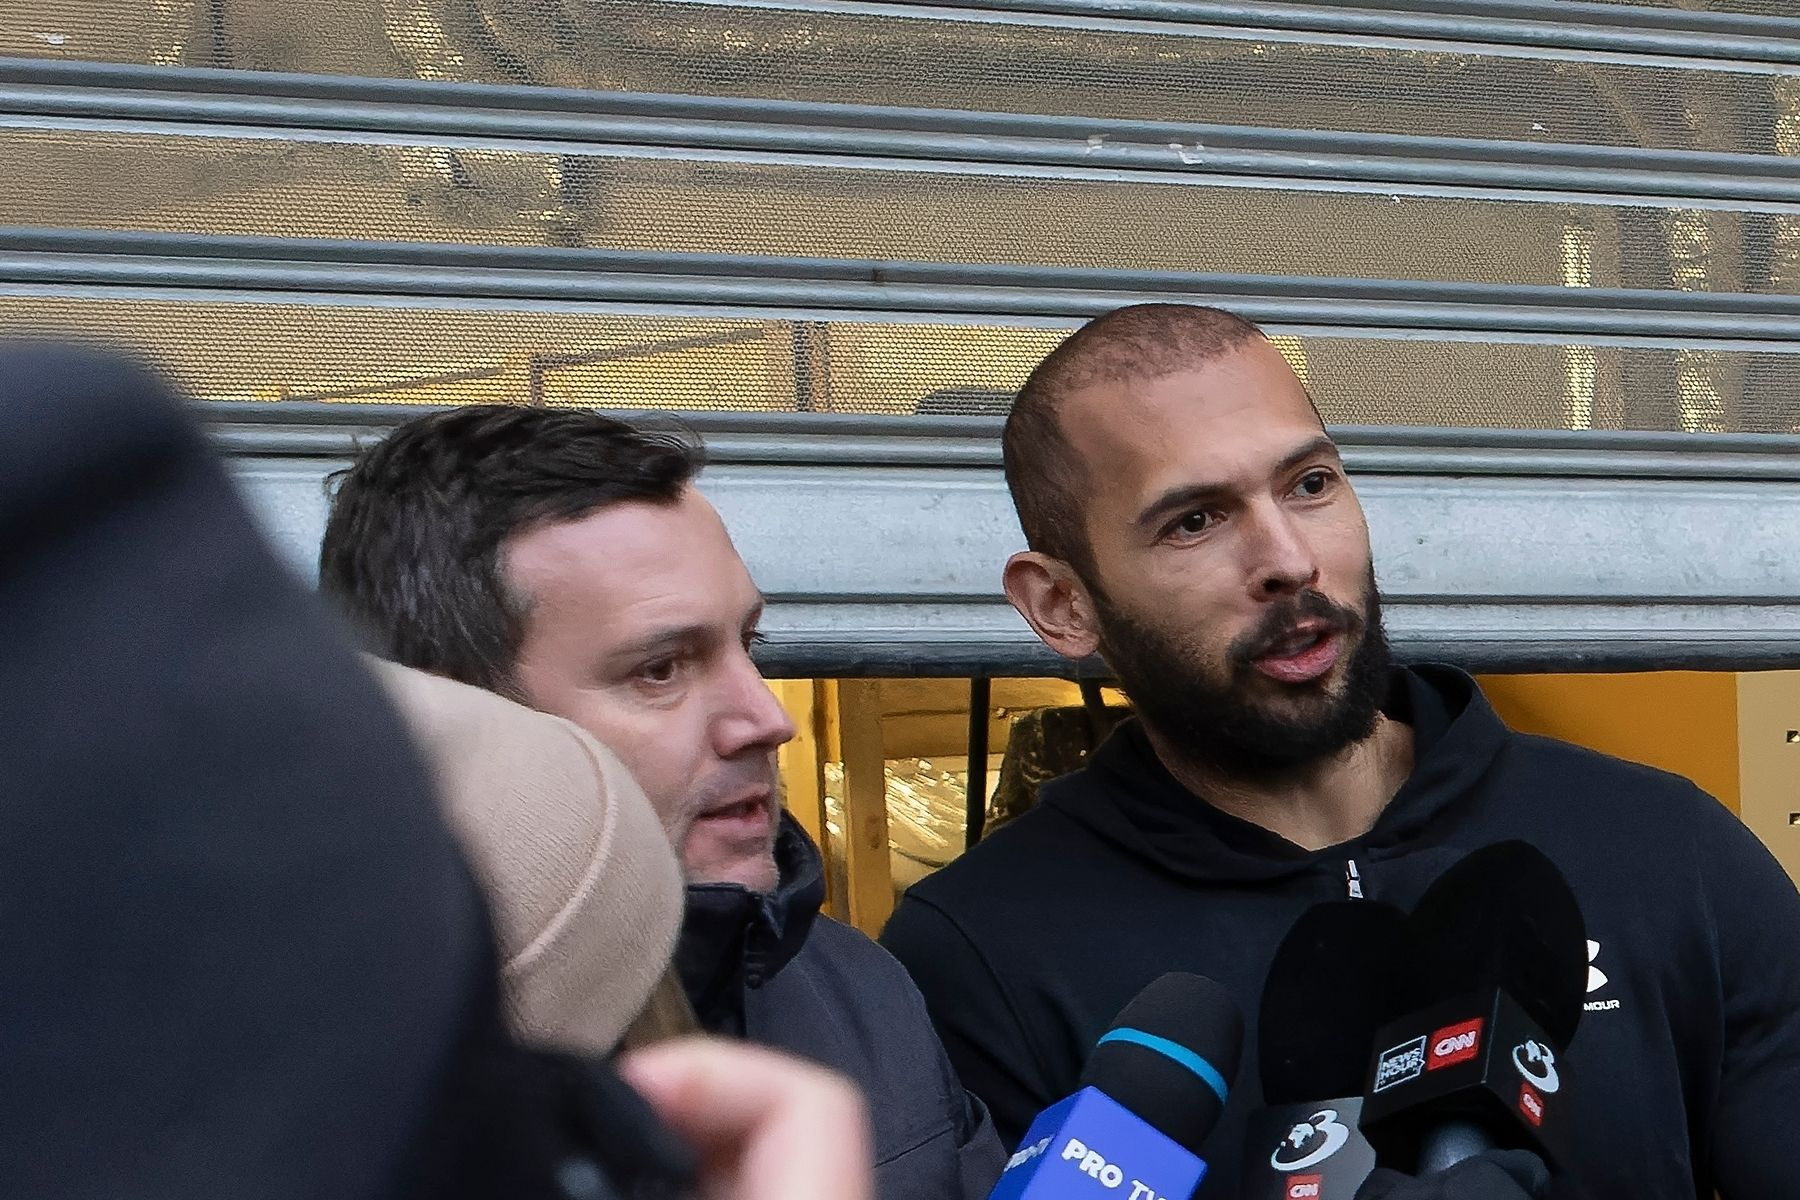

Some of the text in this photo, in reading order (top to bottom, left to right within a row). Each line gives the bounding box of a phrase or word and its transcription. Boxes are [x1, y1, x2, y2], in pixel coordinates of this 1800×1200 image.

[1583, 999, 1620, 1011] MOUR
[1434, 1030, 1476, 1057] CNN
[1061, 1137, 1124, 1189] PRO
